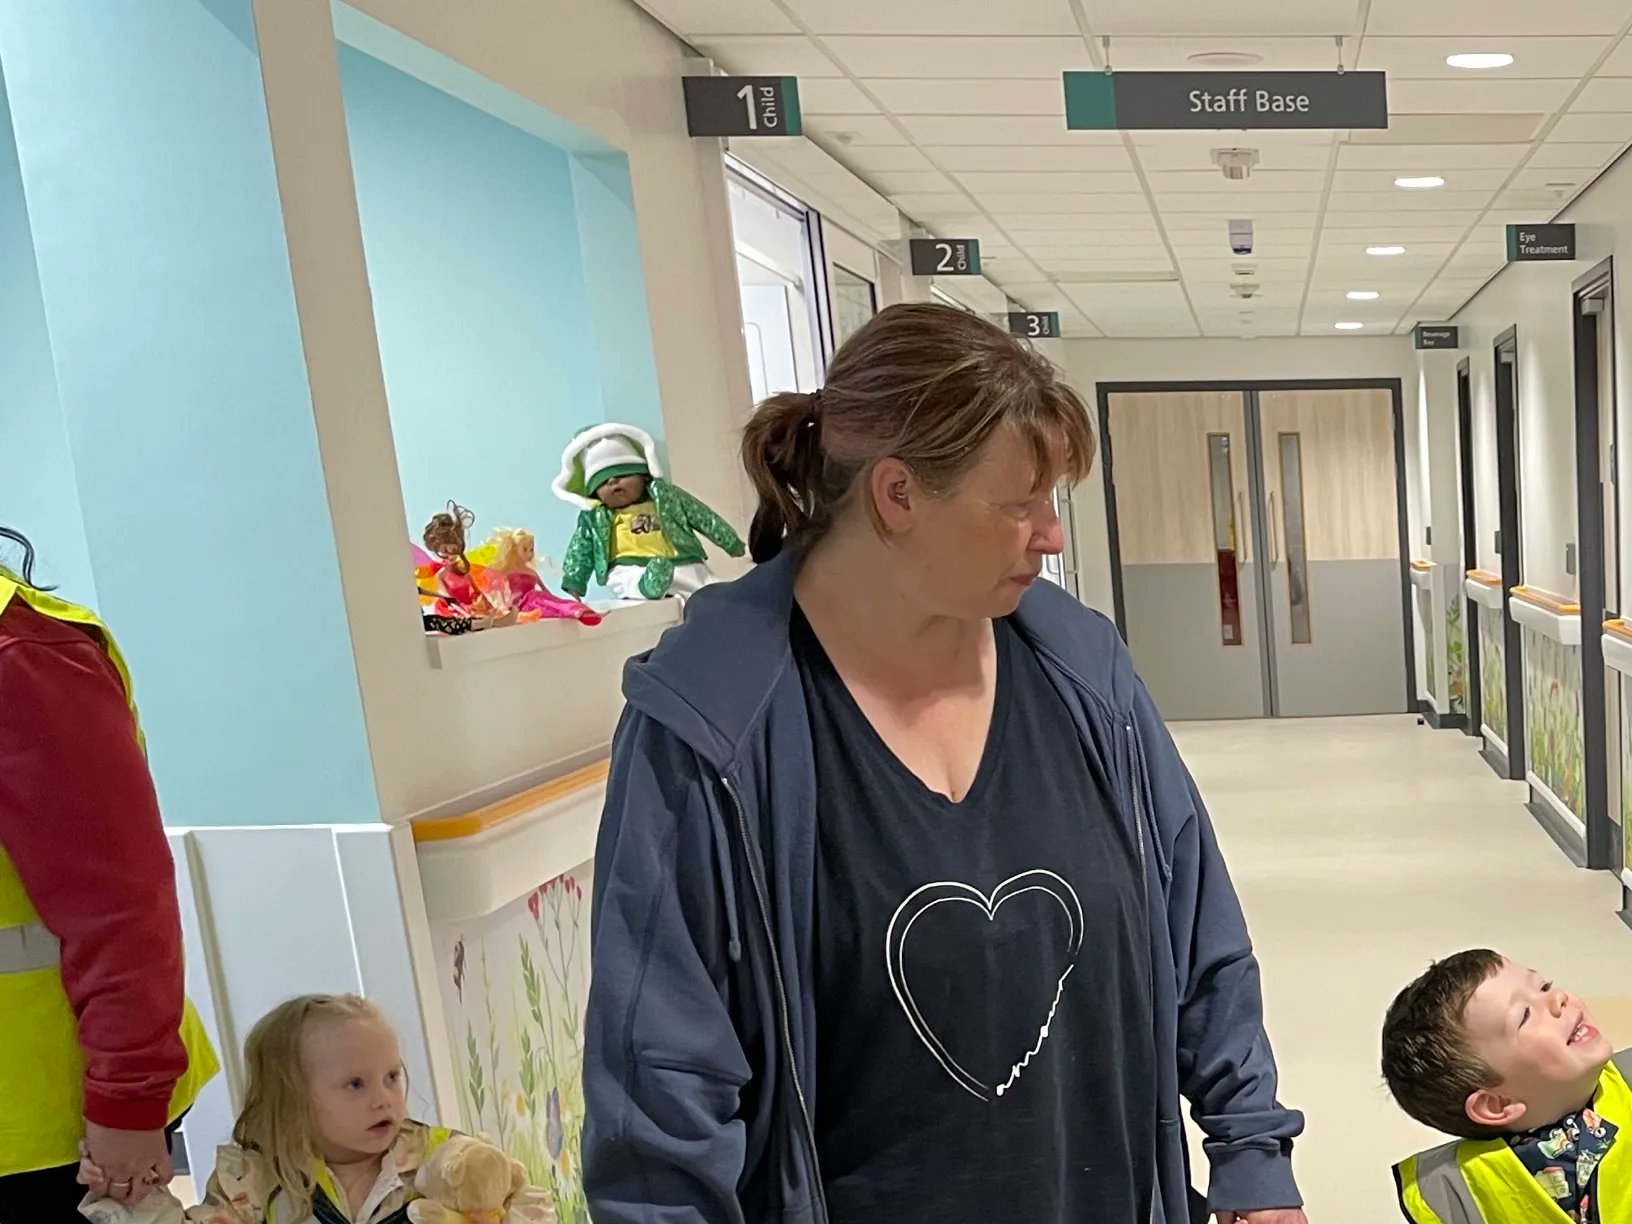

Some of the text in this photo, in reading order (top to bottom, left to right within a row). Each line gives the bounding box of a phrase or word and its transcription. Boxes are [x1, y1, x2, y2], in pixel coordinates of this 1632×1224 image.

[736, 84, 757, 130] 1
[760, 87, 777, 128] Child
[1189, 88, 1310, 112] Staff Base
[1519, 232, 1537, 243] Eye
[1519, 245, 1568, 254] Treatment
[935, 243, 954, 272] 2
[956, 244, 967, 270] Child
[1026, 315, 1040, 336] 3
